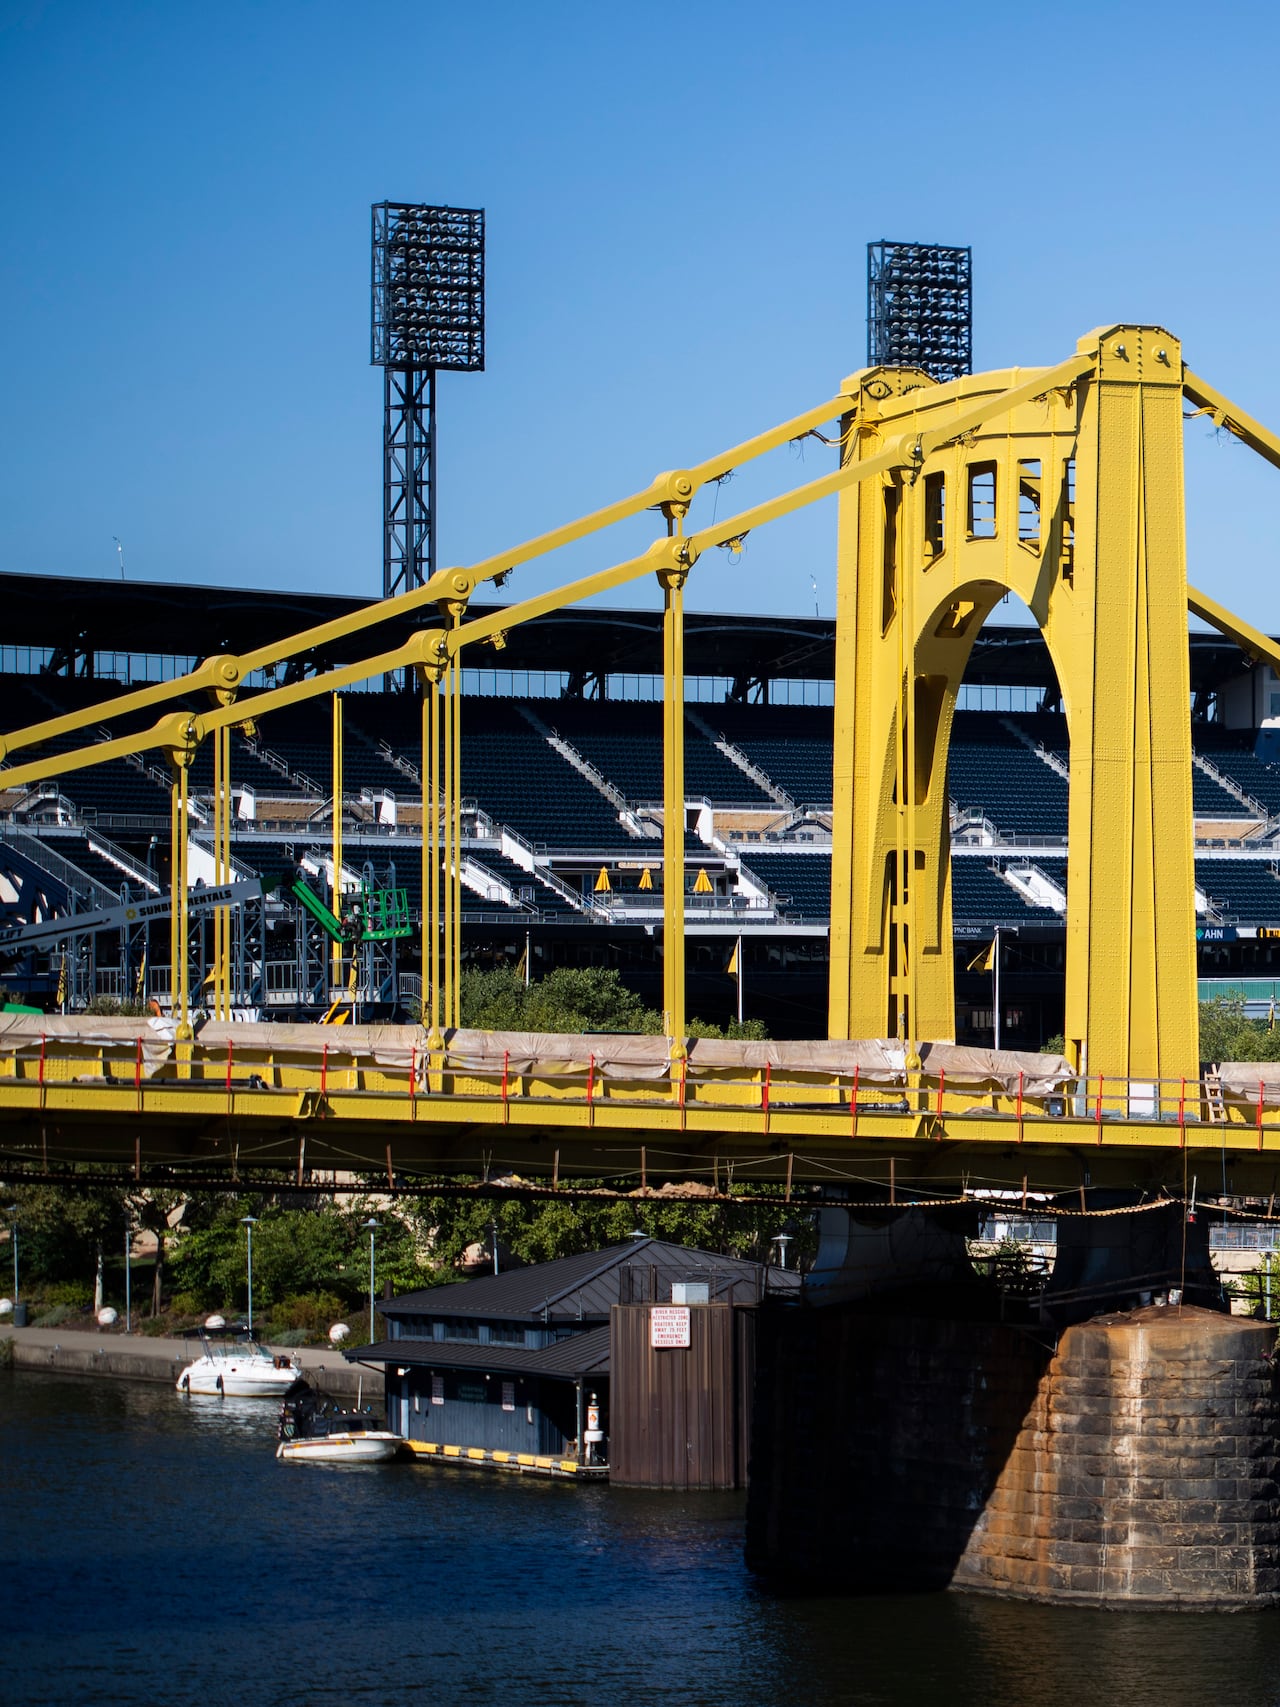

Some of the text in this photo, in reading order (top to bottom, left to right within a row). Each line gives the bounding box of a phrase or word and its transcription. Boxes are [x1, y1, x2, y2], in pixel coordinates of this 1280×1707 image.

[139, 890, 232, 917] SUNB RENTALS
[1204, 929, 1224, 939] AHN
